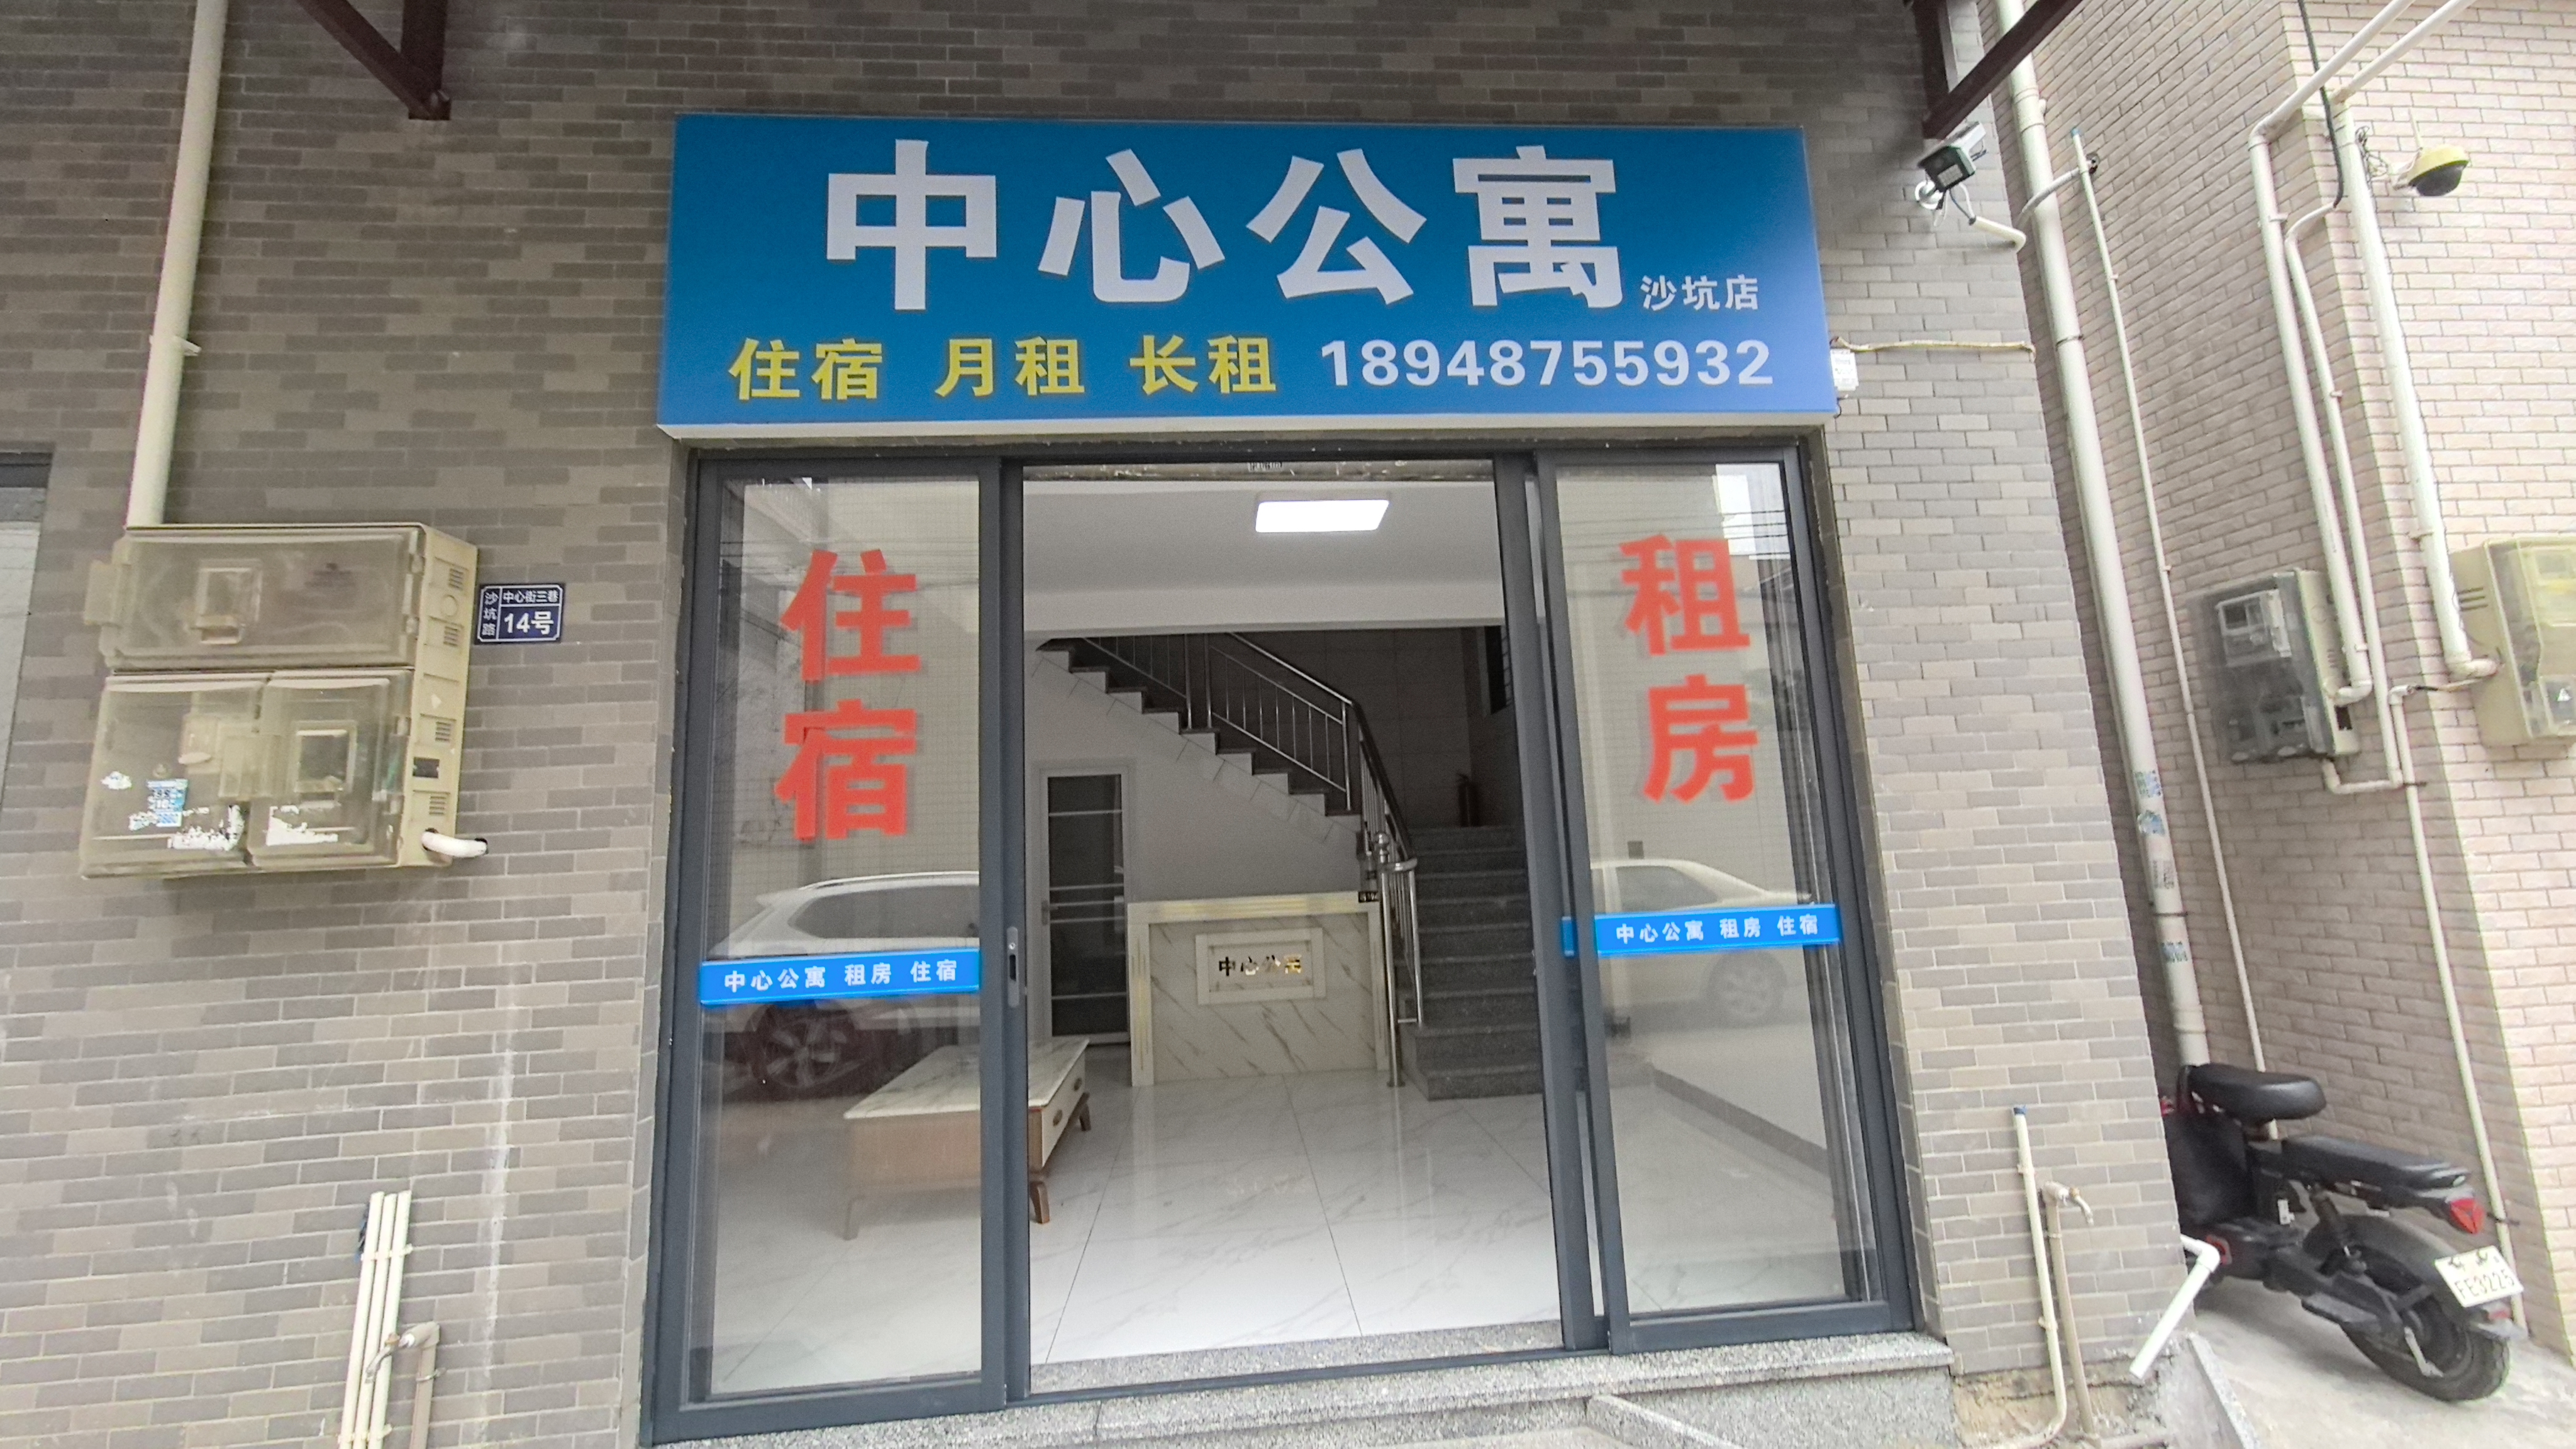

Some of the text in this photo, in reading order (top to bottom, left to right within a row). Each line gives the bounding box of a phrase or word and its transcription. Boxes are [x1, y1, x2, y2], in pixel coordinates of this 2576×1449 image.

[826, 140, 1623, 311] 中心公寓
[1640, 274, 1759, 312] 沙坑店
[730, 336, 1276, 401] 住宿 月租 长租
[1321, 338, 1775, 389] 18948755932
[504, 611, 554, 635] 14号
[774, 549, 922, 841] 住宿
[1620, 535, 1759, 804] 租房
[1616, 913, 1819, 945] 中心公寓 租房 住宿
[724, 959, 957, 993] 中心公寓 租房 住宿
